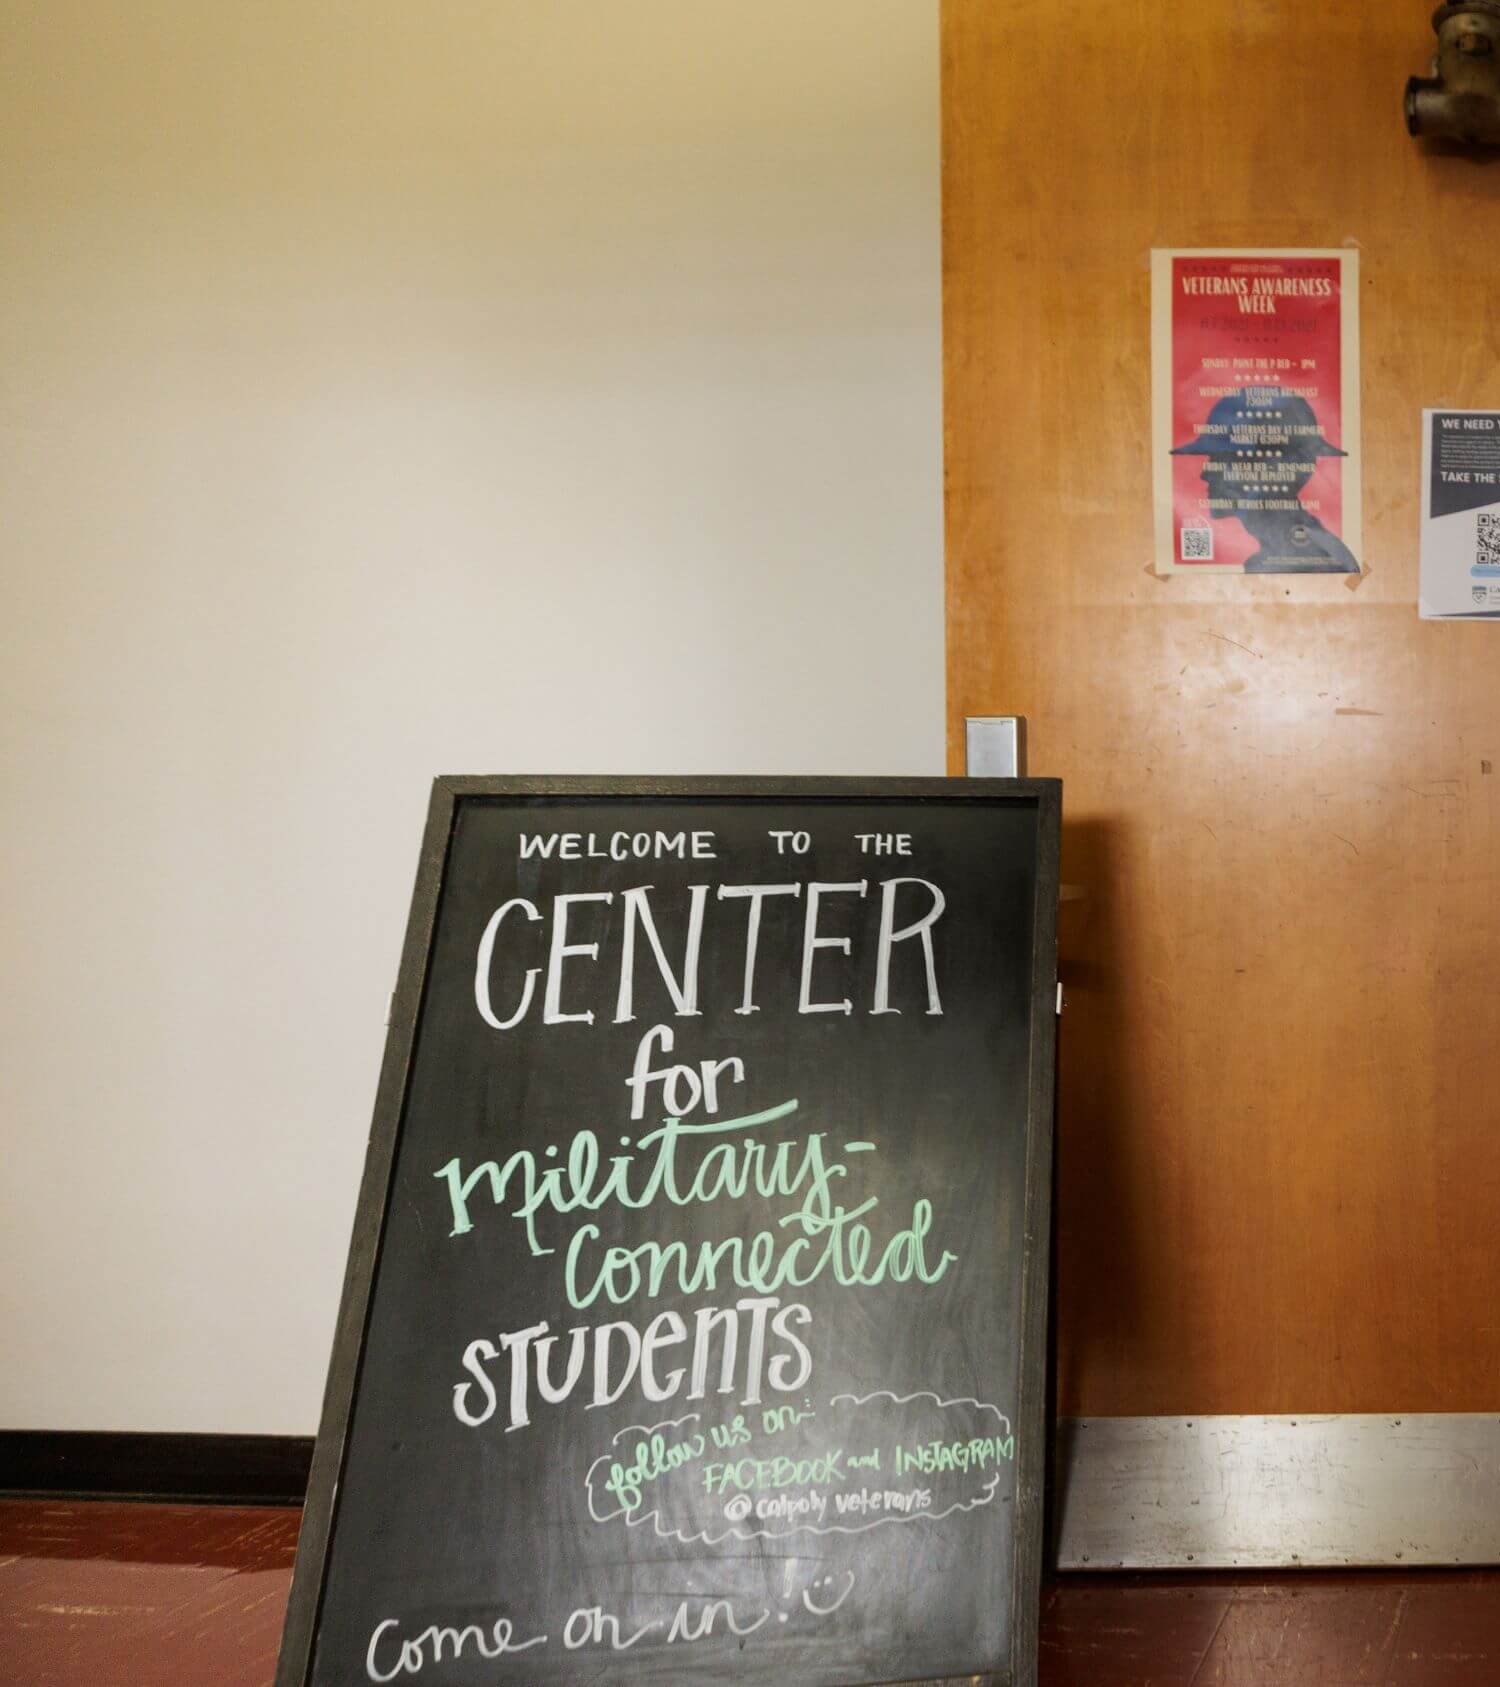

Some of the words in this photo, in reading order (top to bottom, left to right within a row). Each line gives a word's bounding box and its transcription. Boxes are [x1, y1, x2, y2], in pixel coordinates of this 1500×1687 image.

[1182, 277, 1249, 295] VETERANS
[1251, 277, 1332, 296] AWARENESS
[1238, 296, 1276, 314] WEEK
[1441, 418, 1460, 429] WE
[1463, 419, 1495, 430] NEED
[1440, 471, 1471, 483] TAKE
[1474, 472, 1496, 484] THE
[519, 830, 718, 860] WELCOME
[768, 830, 811, 855] TO
[855, 833, 912, 856] THE
[474, 877, 946, 1029] CENTER
[625, 1024, 744, 1120] for
[711, 1414, 752, 1448] us
[703, 1449, 846, 1495] FACEBOOK
[847, 1448, 880, 1470] and
[895, 1434, 1015, 1476] INSTAGRAM
[836, 1489, 932, 1515] veterans
[563, 1606, 664, 1650] on
